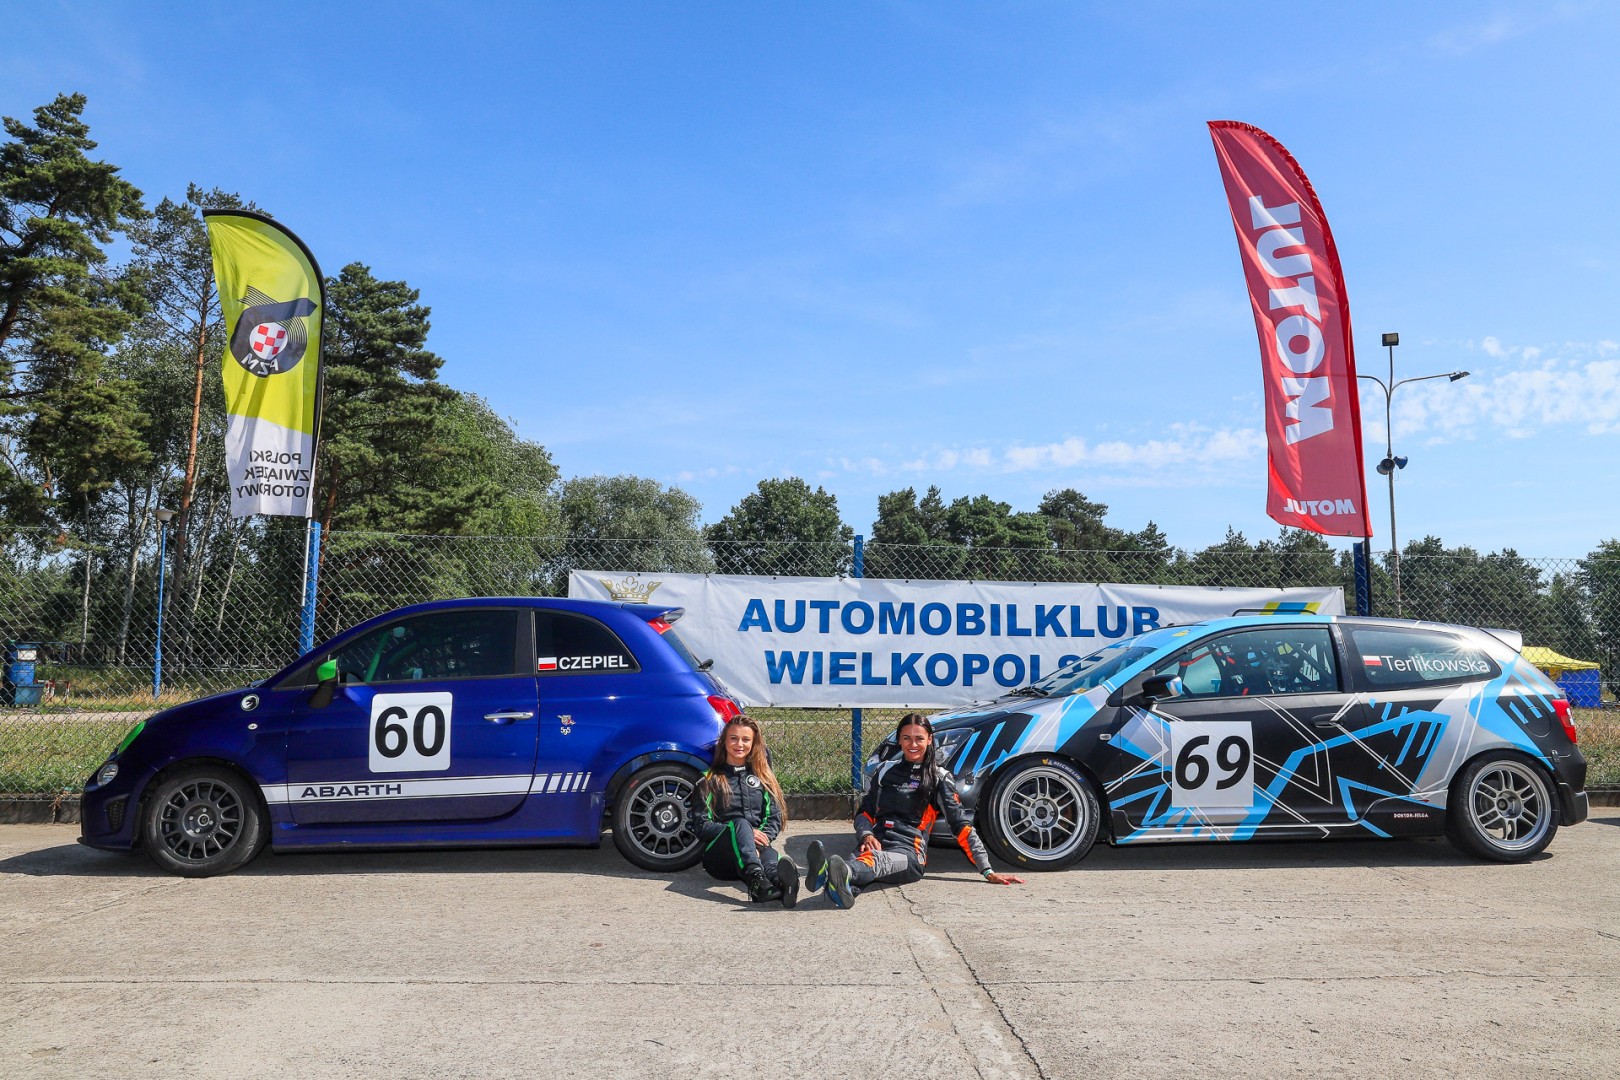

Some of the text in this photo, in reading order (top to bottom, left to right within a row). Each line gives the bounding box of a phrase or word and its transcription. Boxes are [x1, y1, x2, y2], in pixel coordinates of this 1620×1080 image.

[738, 599, 1160, 638] AUTOMOBILKLUB
[559, 656, 628, 669] CZEPIEL
[1381, 655, 1490, 672] Terlikowska
[375, 705, 445, 758] 60
[1053, 761, 1082, 780] MICHELIN
[1175, 735, 1250, 790] 69
[301, 784, 401, 797] ABARTH
